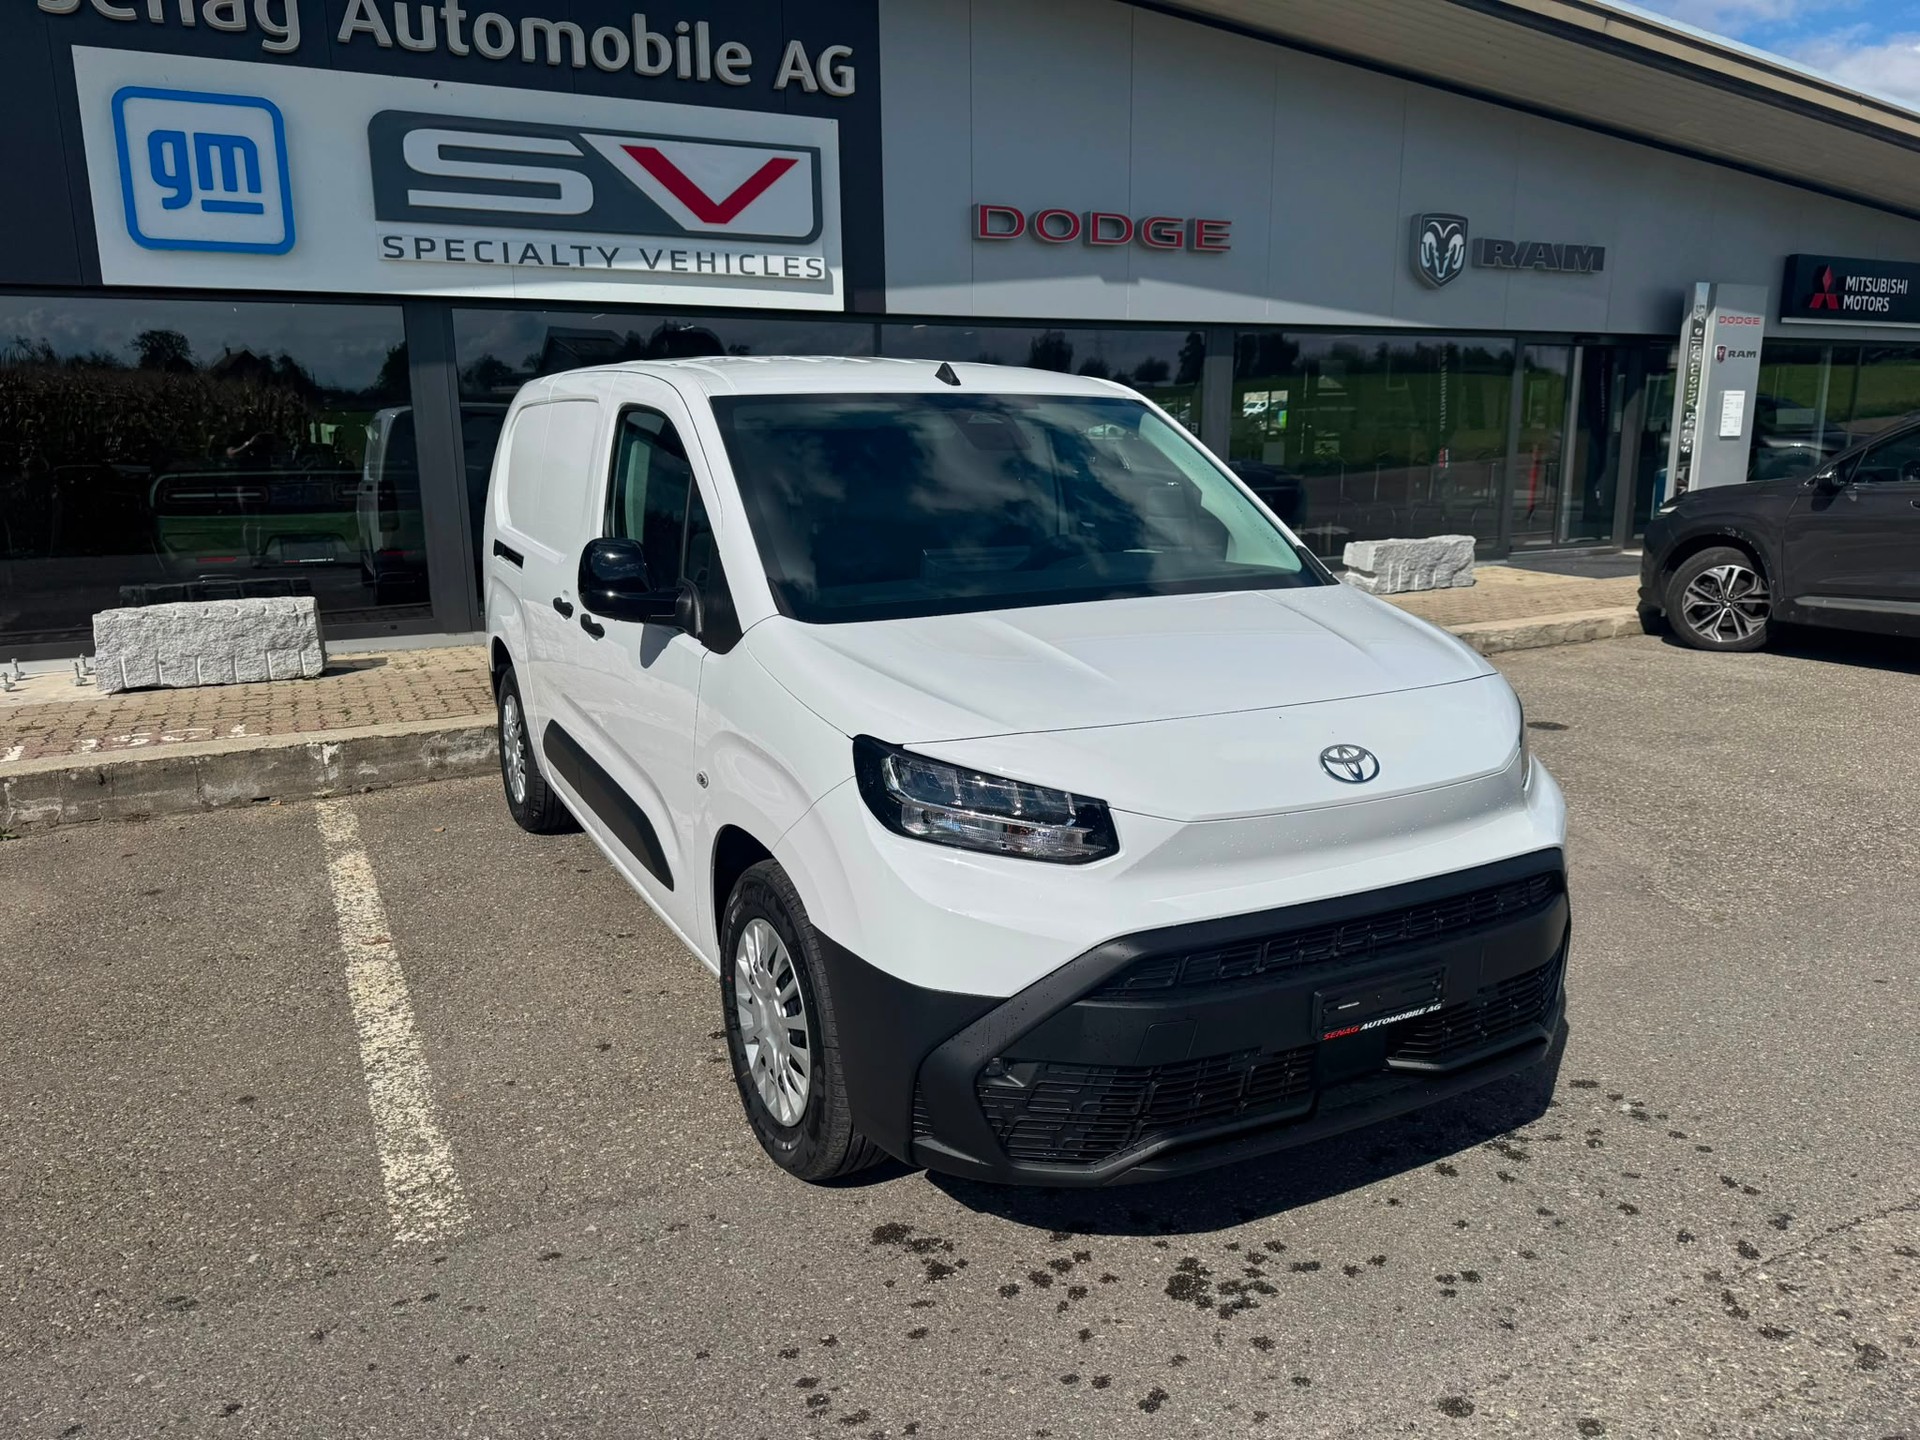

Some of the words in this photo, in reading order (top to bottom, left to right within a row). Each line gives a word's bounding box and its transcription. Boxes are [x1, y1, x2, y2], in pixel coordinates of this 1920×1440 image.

[337, 0, 752, 86] Automobile
[773, 40, 855, 97] AG
[147, 129, 263, 212] gm
[402, 128, 799, 224] SV
[973, 203, 1232, 252] DODGE
[382, 235, 620, 269] SPECIALTY
[639, 247, 825, 279] VEHICLES
[1473, 237, 1606, 273] RAM
[1843, 295, 1890, 312] MOTORS
[1845, 275, 1909, 295] MITSUBISHI
[1718, 315, 1761, 326] DODGE
[1728, 350, 1757, 359] RAM
[1322, 1025, 1359, 1040] SENAG
[1359, 1007, 1427, 1031] AUTOMOBILE
[1425, 1003, 1442, 1014] AG
